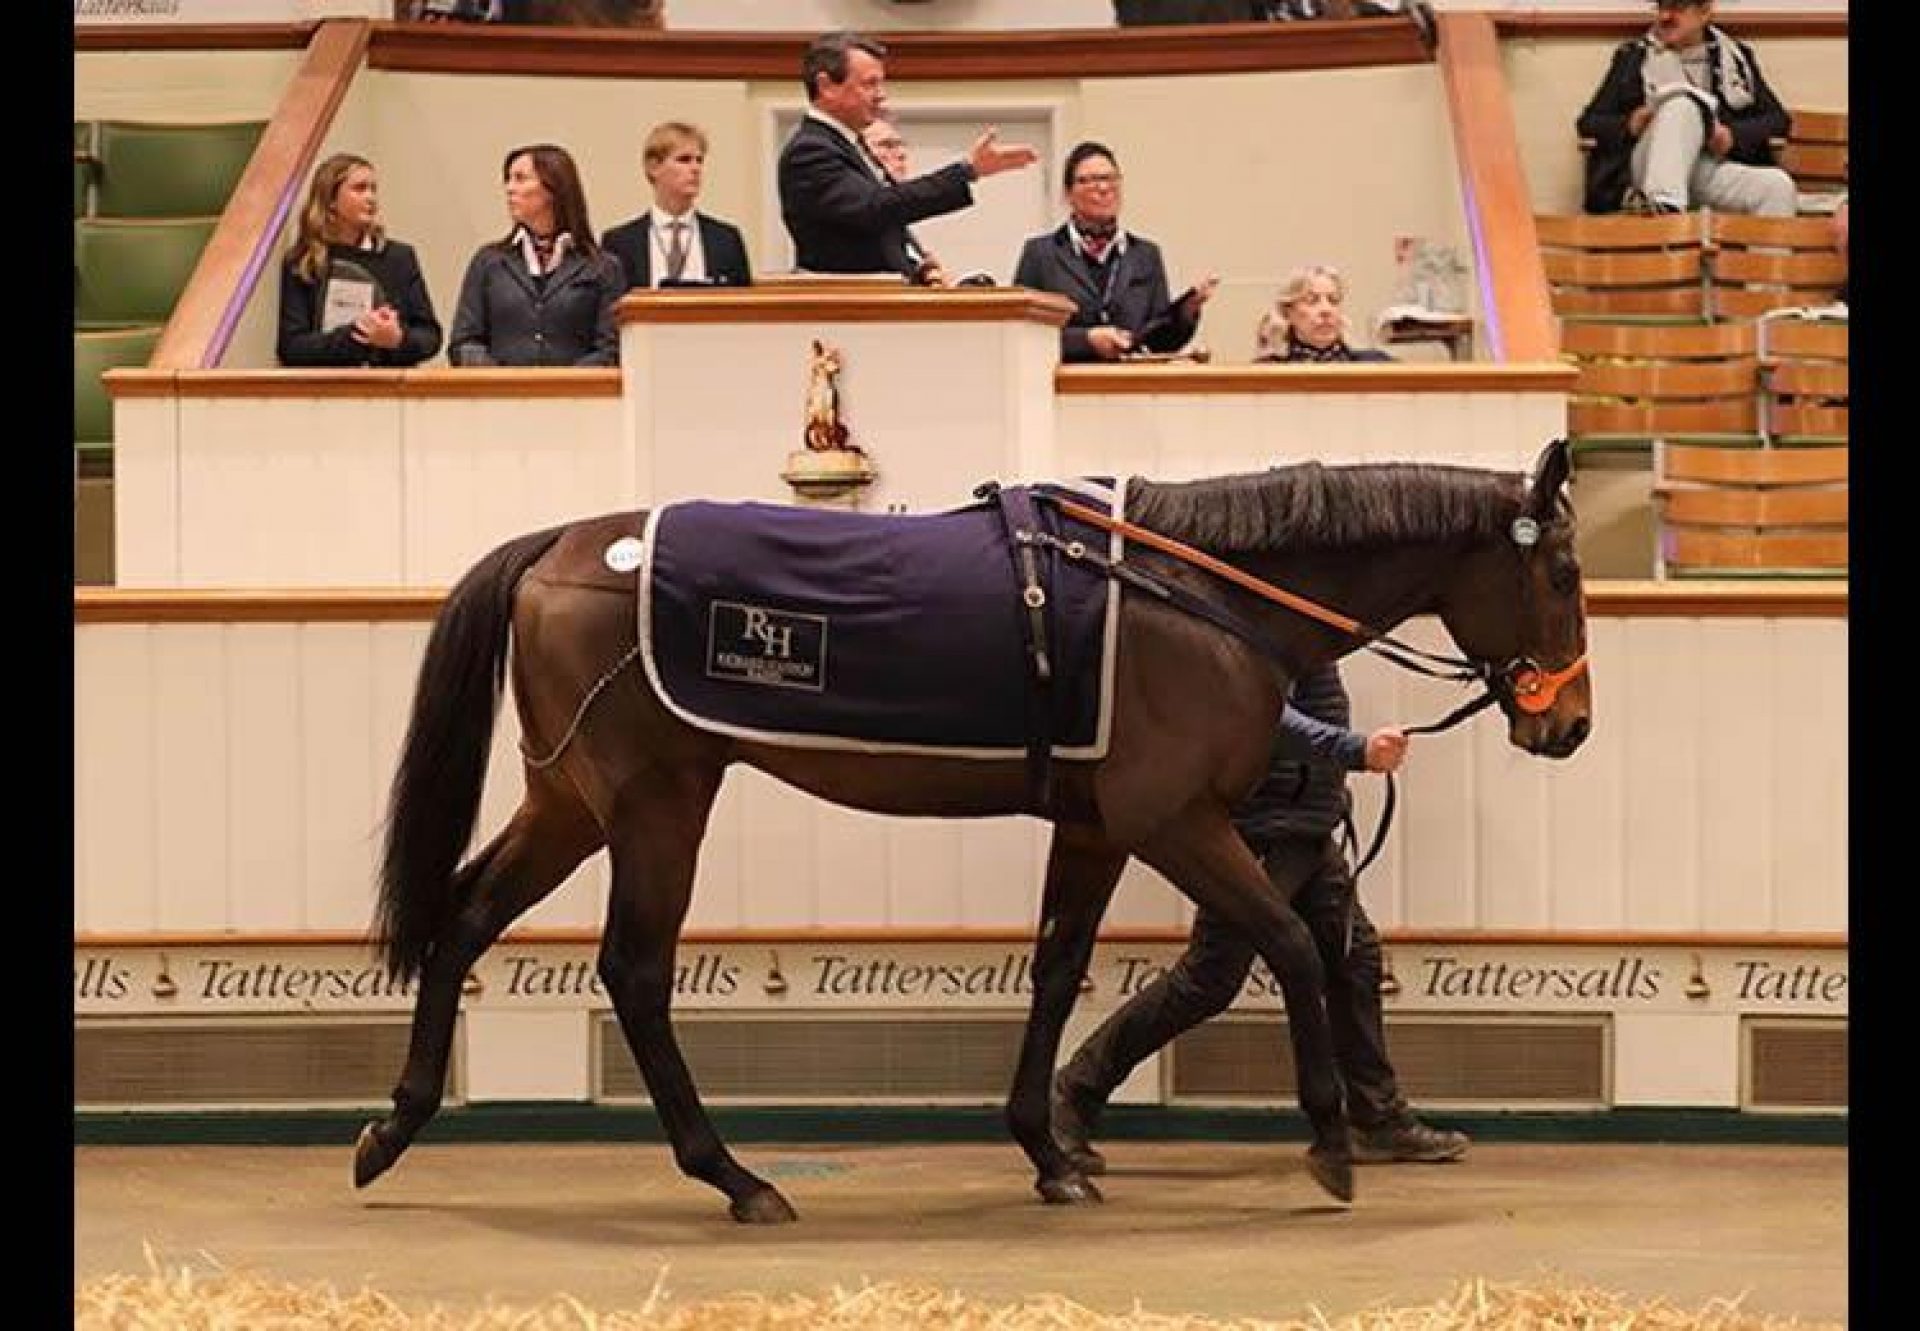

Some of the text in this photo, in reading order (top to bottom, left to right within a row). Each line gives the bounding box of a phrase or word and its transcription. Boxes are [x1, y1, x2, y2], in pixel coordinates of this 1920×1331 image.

[76, 959, 130, 998] lls
[198, 960, 410, 997] Tattersal
[503, 955, 741, 995] Tattlls
[811, 954, 1034, 995] Tattersall
[1423, 957, 1662, 998] Tattersalls
